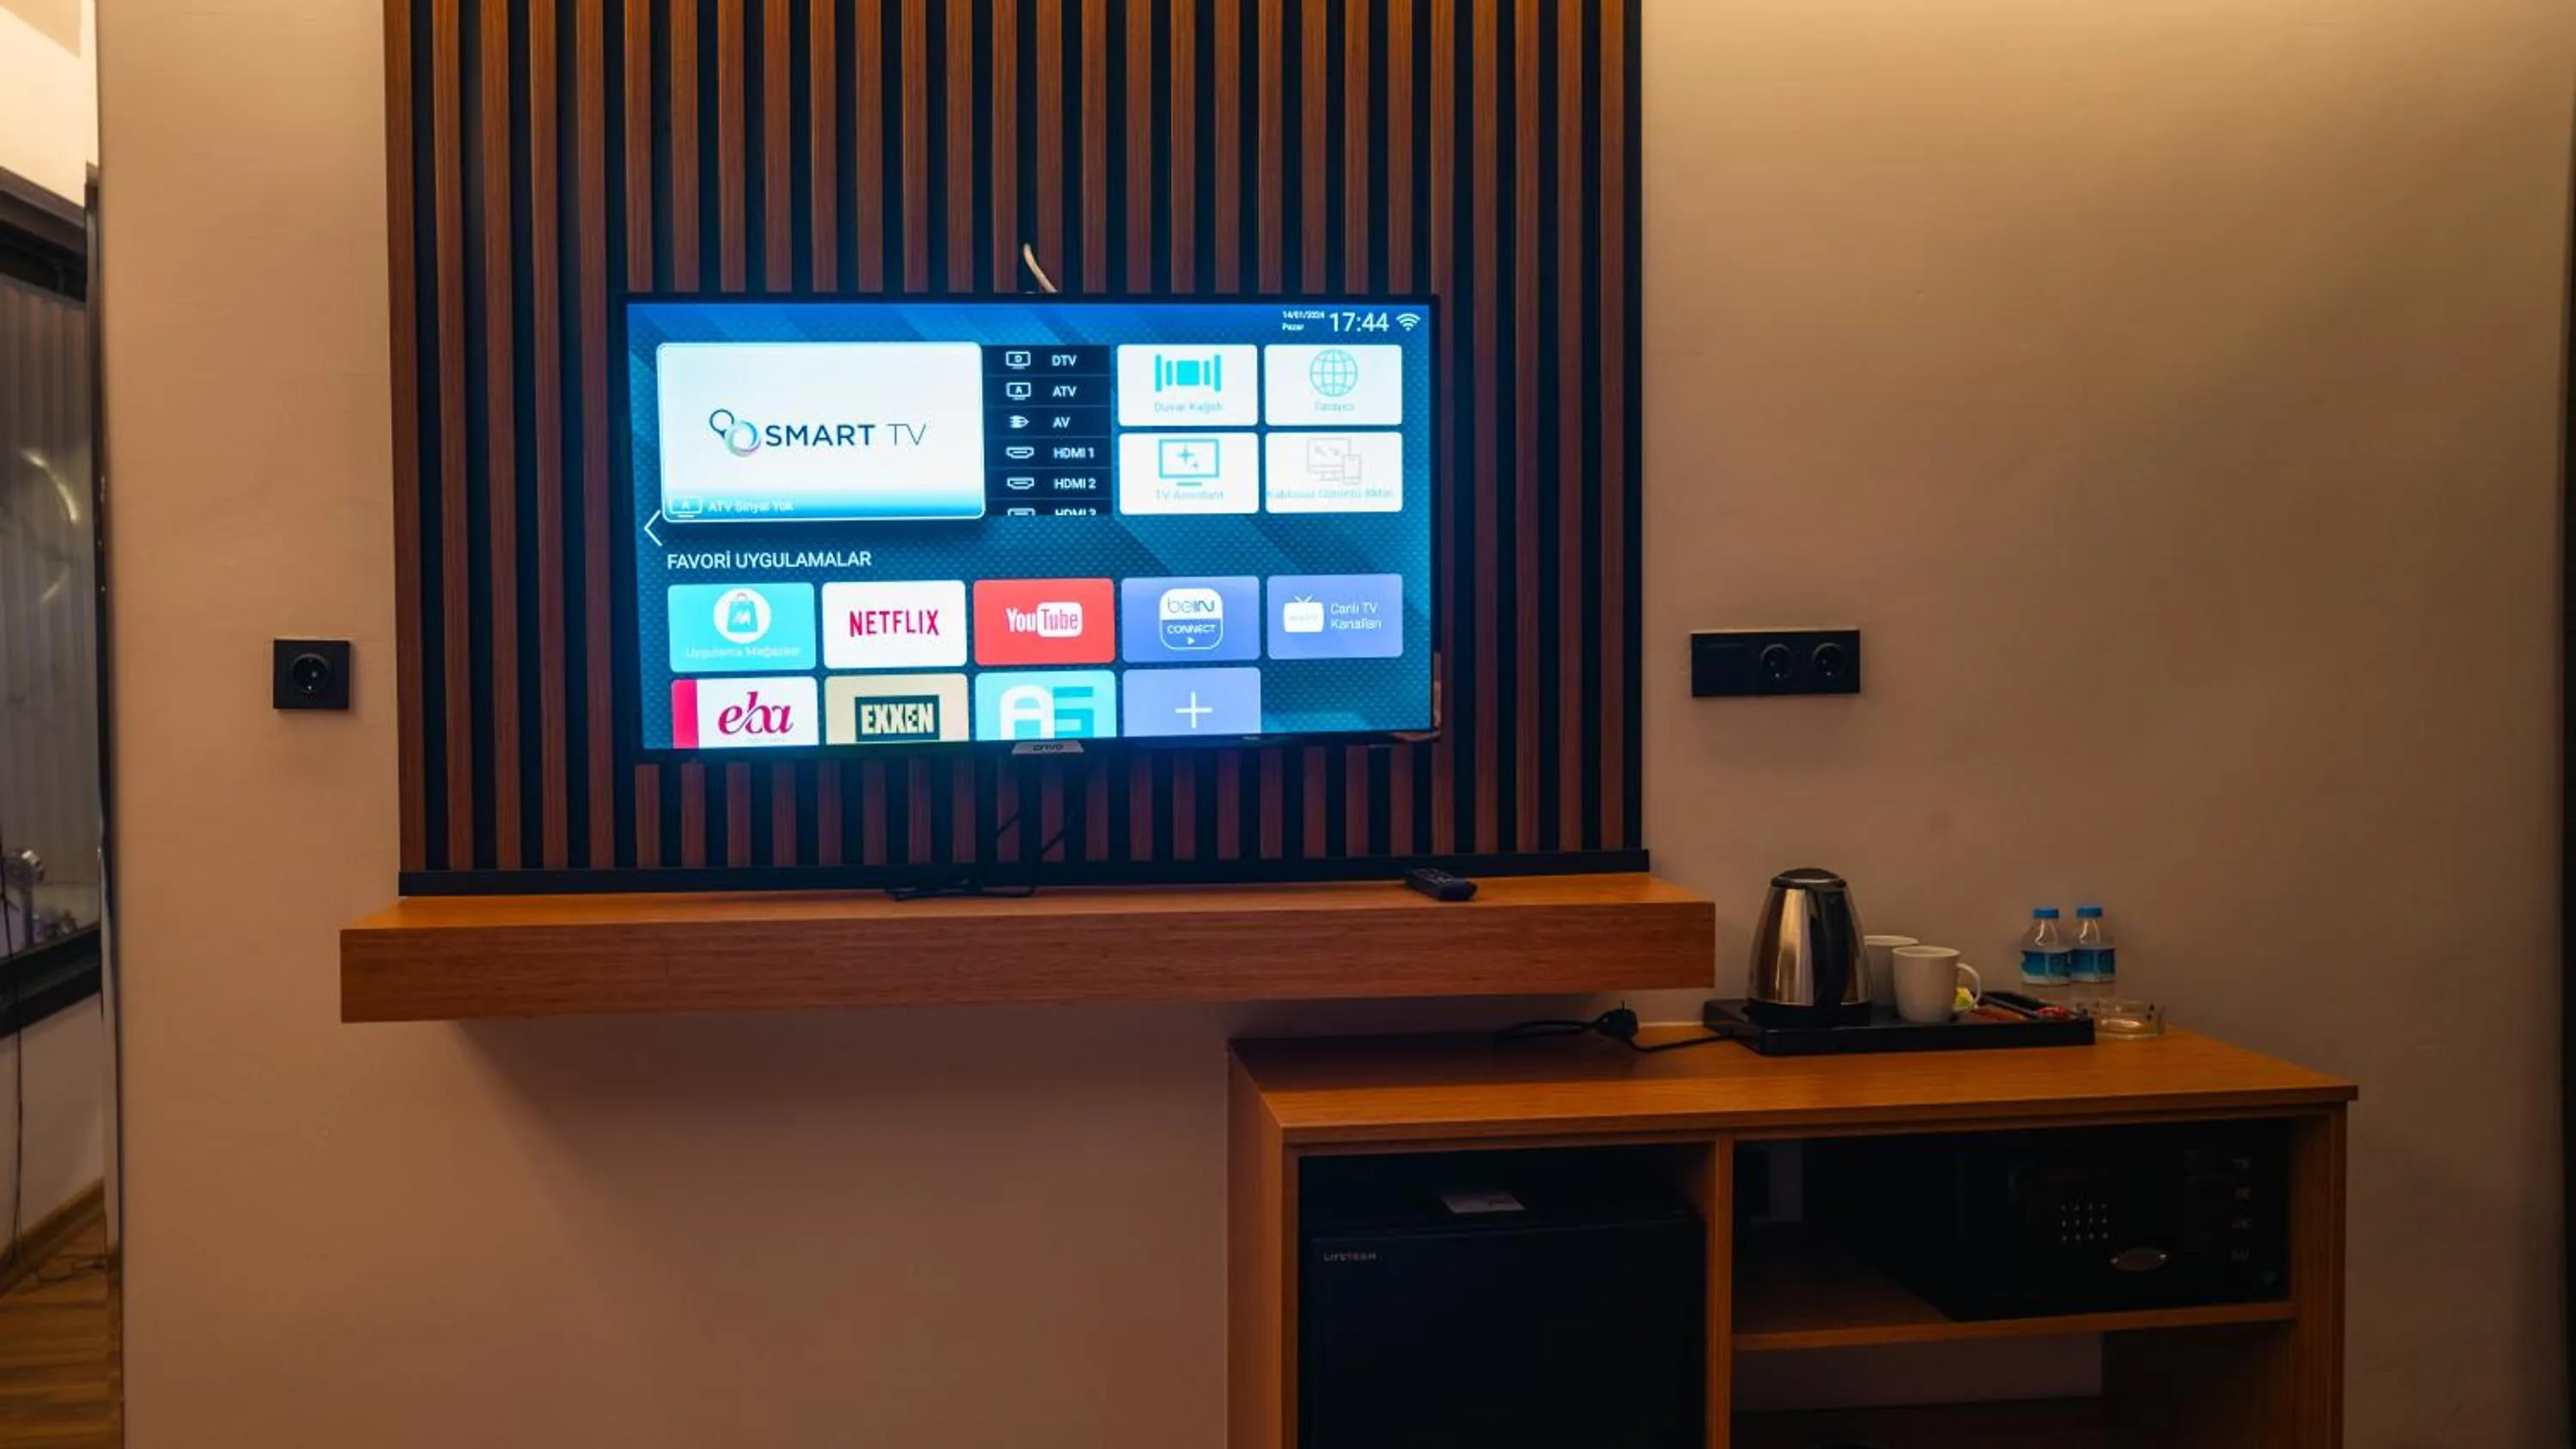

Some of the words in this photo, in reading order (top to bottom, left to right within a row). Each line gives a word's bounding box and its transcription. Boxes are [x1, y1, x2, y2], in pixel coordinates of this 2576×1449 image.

[1329, 312, 1390, 332] 17:44
[1052, 355, 1078, 367] DTV
[1052, 385, 1078, 397] ATV
[1053, 416, 1070, 428] AV
[766, 424, 876, 446] SMART
[887, 423, 927, 446] TV
[1054, 447, 1085, 459] HDMI
[1089, 446, 1095, 458] 1
[1054, 478, 1086, 490] HDMI
[1088, 478, 1097, 489] 2
[1055, 507, 1086, 516] HDMI
[667, 551, 732, 569] FAVORİ
[736, 551, 872, 568] UYGULAMALAR
[1362, 602, 1379, 614] TV
[849, 609, 940, 637] NETFLIX
[1006, 606, 1078, 634] YouTube
[1167, 624, 1216, 634] CONNECT
[718, 691, 794, 736] eba
[861, 703, 935, 735] EXXEN
